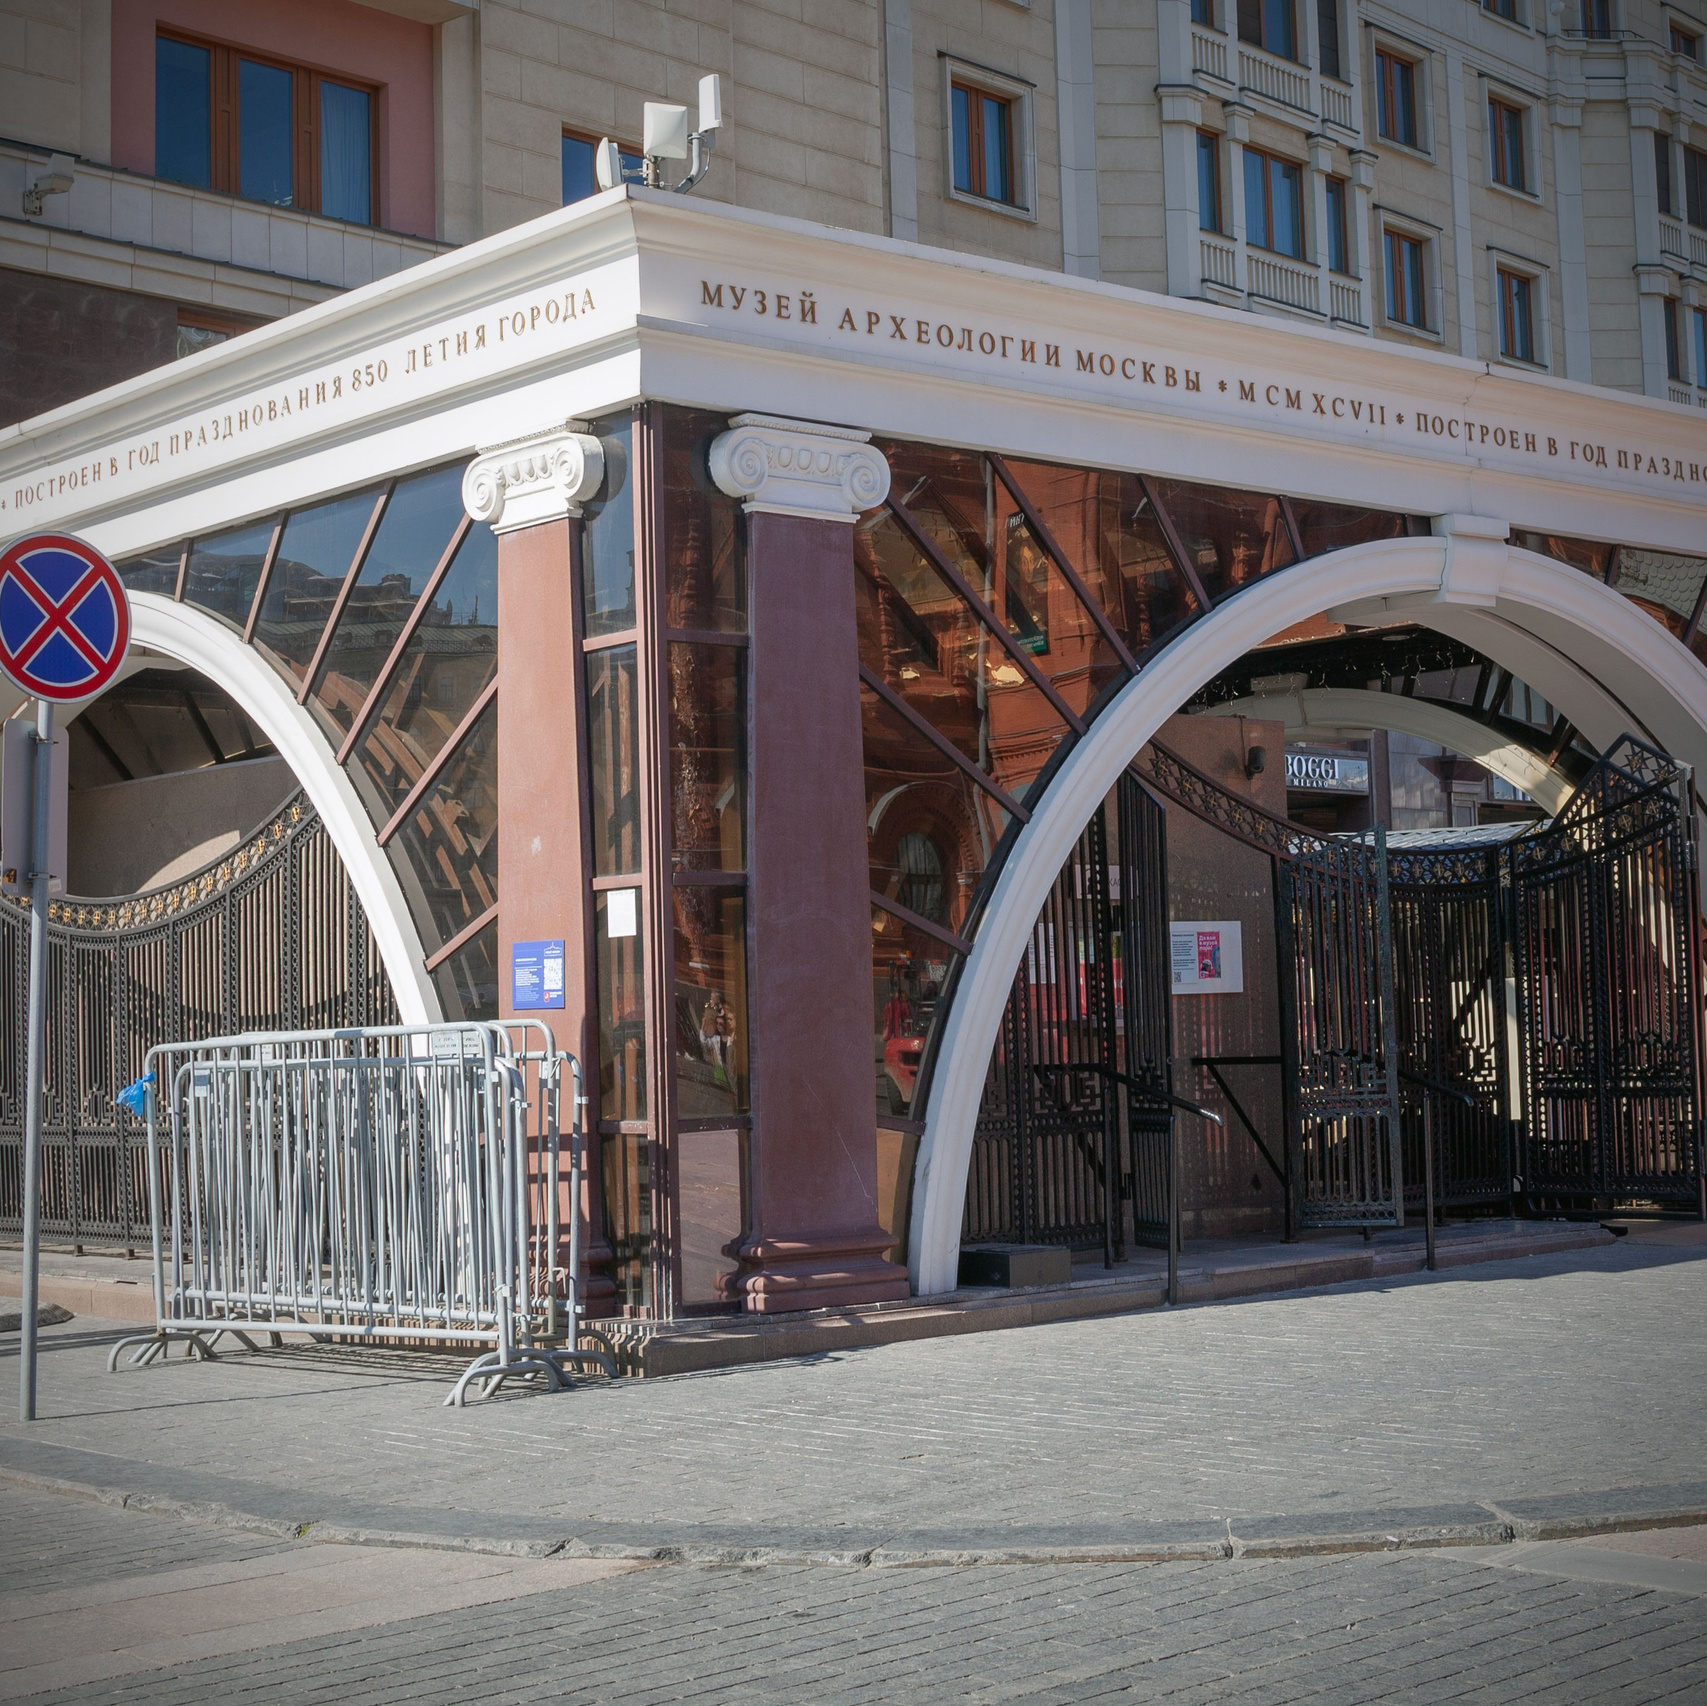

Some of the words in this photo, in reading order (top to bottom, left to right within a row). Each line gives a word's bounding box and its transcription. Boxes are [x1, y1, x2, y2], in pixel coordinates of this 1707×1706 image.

[14, 461, 102, 510] ПОСТРОЕН
[109, 456, 119, 477] В
[128, 441, 160, 471] ГОД
[169, 375, 343, 456] ПРАЗДНОВАНИЯ
[351, 359, 389, 392] 850
[404, 324, 486, 375] ЛЕТИЯ
[498, 287, 596, 342] ГОРОДА
[700, 279, 818, 325] МУЗЕЙ
[837, 307, 1062, 368] АРХЕОЛОГИИ
[1075, 349, 1202, 393] МОСКВЫ
[1415, 411, 1538, 453] ПОСТРОЕН
[1546, 436, 1559, 457] В
[1569, 440, 1608, 469] ГОД
[1285, 754, 1339, 779] BOGGI
[1293, 778, 1329, 788] MILANO
